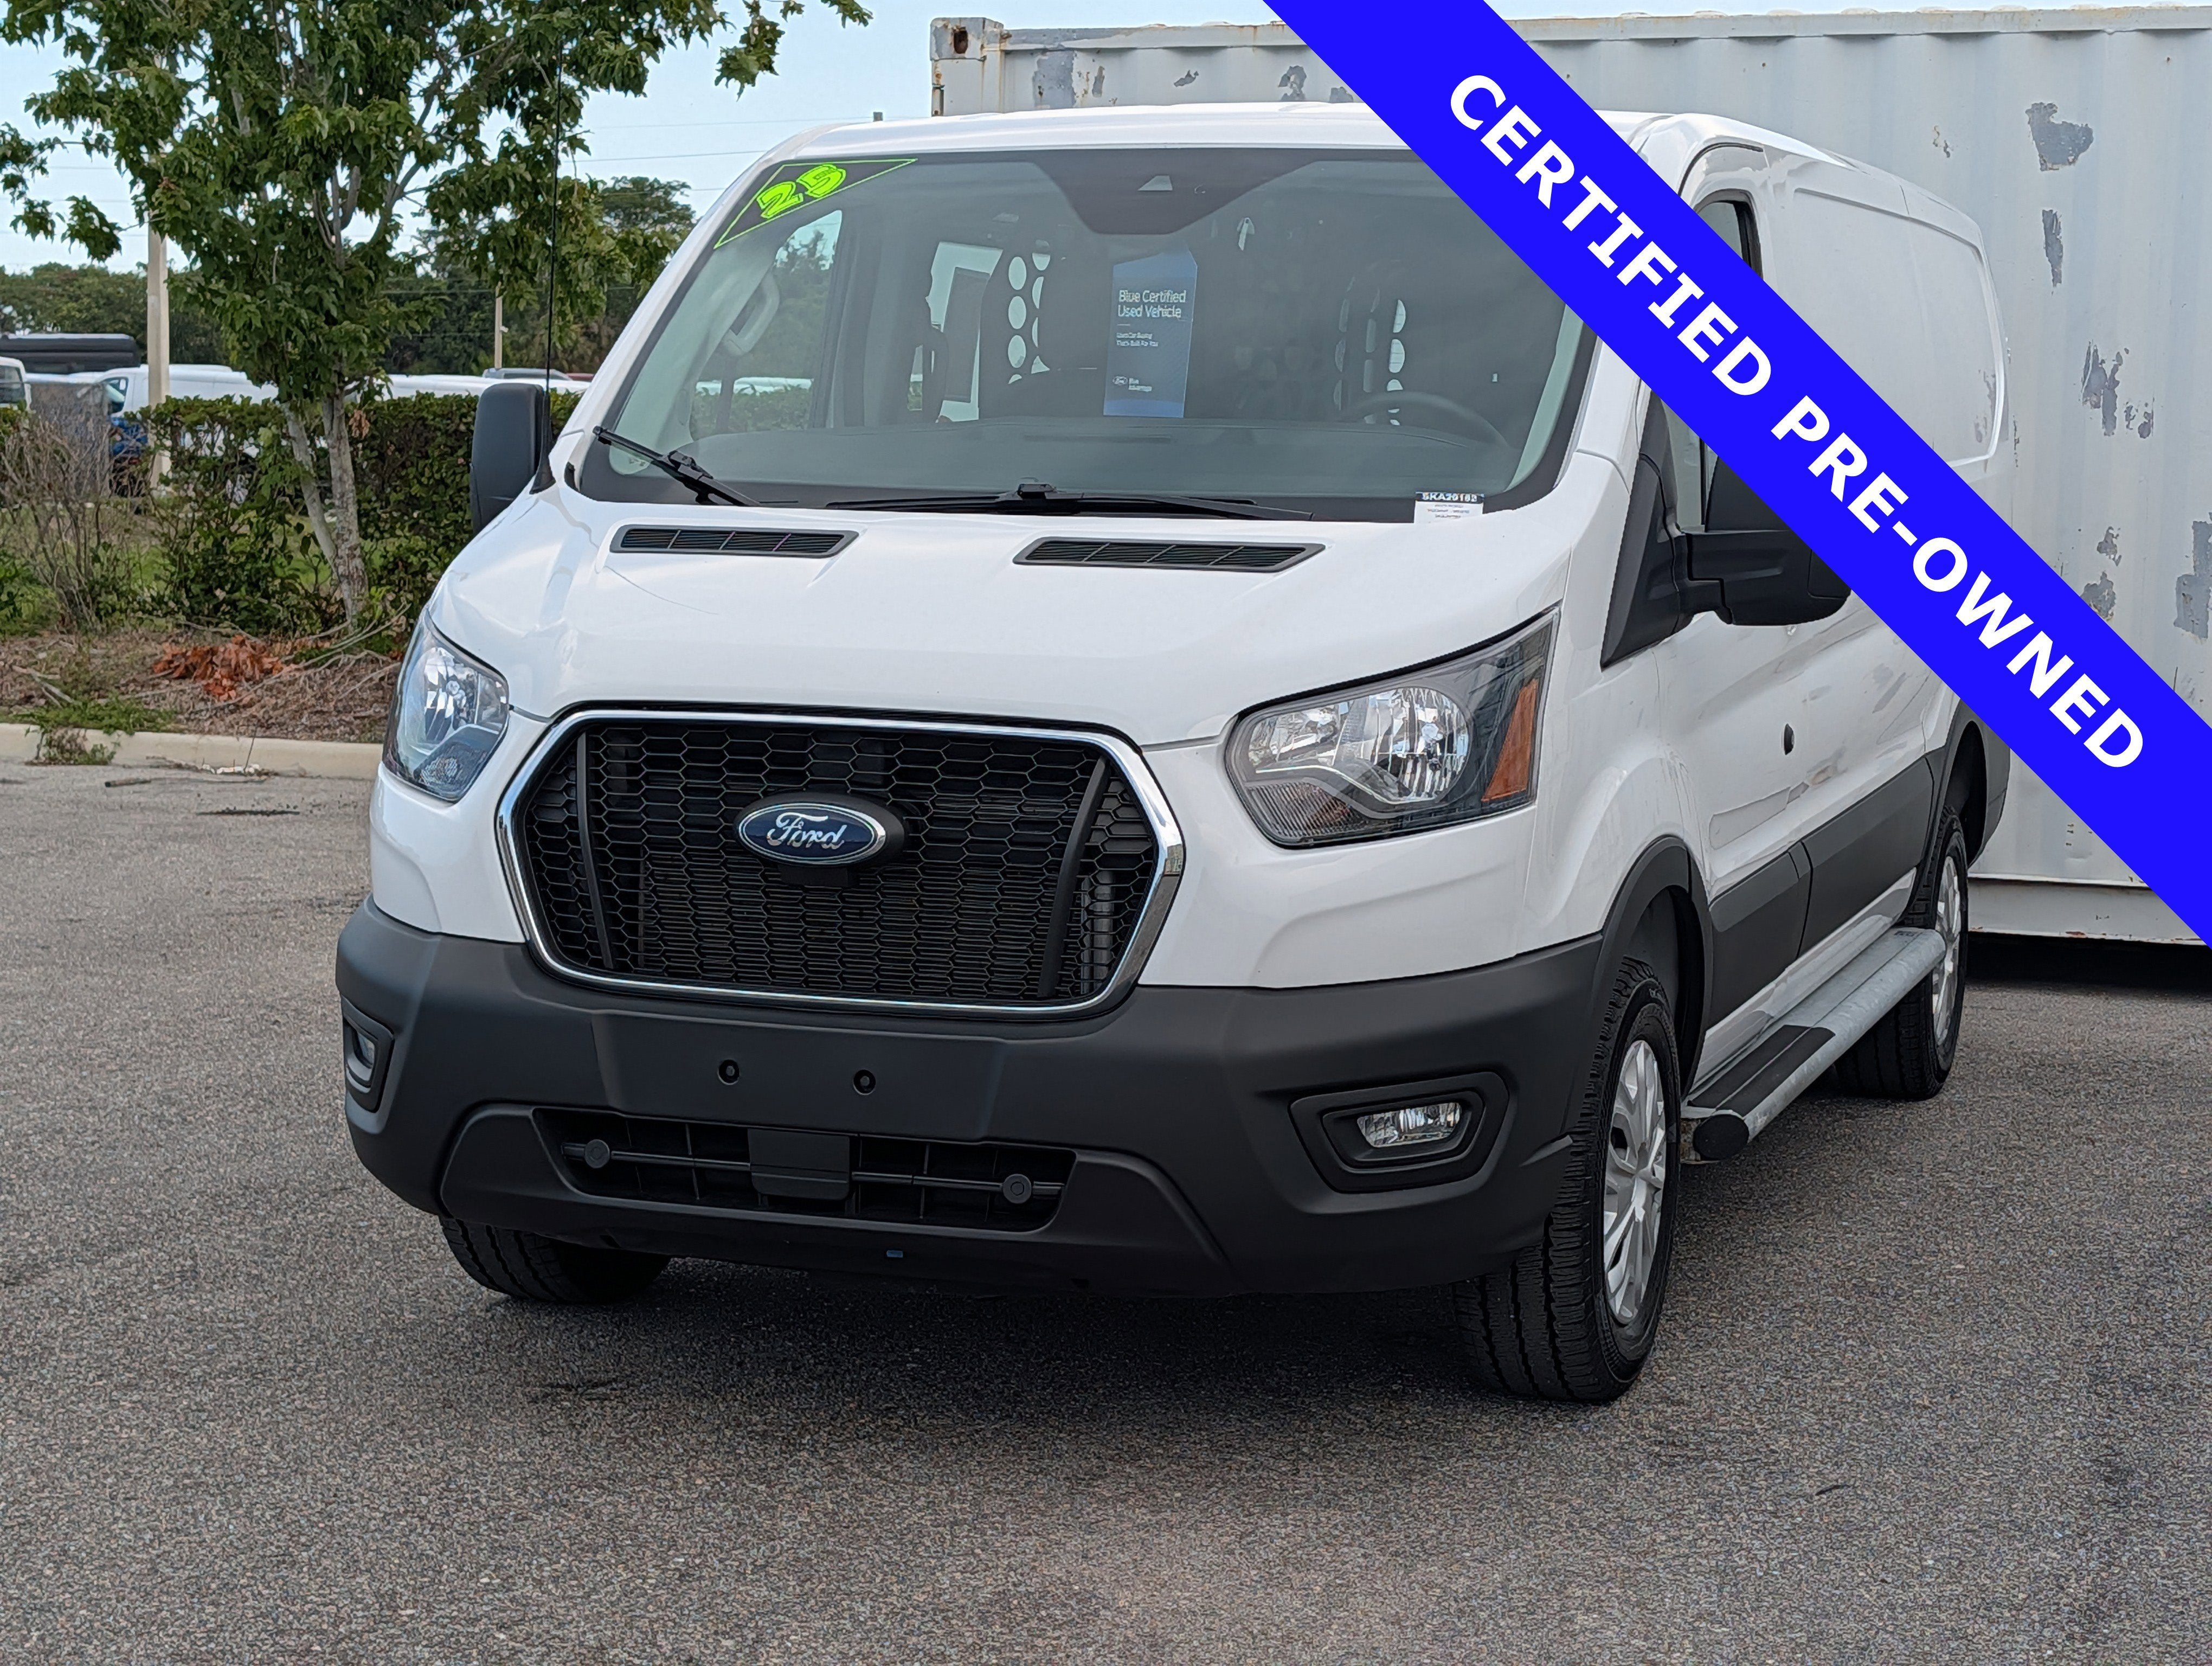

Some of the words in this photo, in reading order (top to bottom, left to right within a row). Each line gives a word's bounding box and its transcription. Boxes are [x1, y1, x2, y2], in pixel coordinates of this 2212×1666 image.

[756, 163, 847, 219] 25
[1118, 290, 1140, 302] Blue
[1142, 290, 1187, 303] Certified
[1118, 304, 1142, 317] Used
[1144, 305, 1181, 318] Vehicle
[766, 811, 848, 850] Ford
